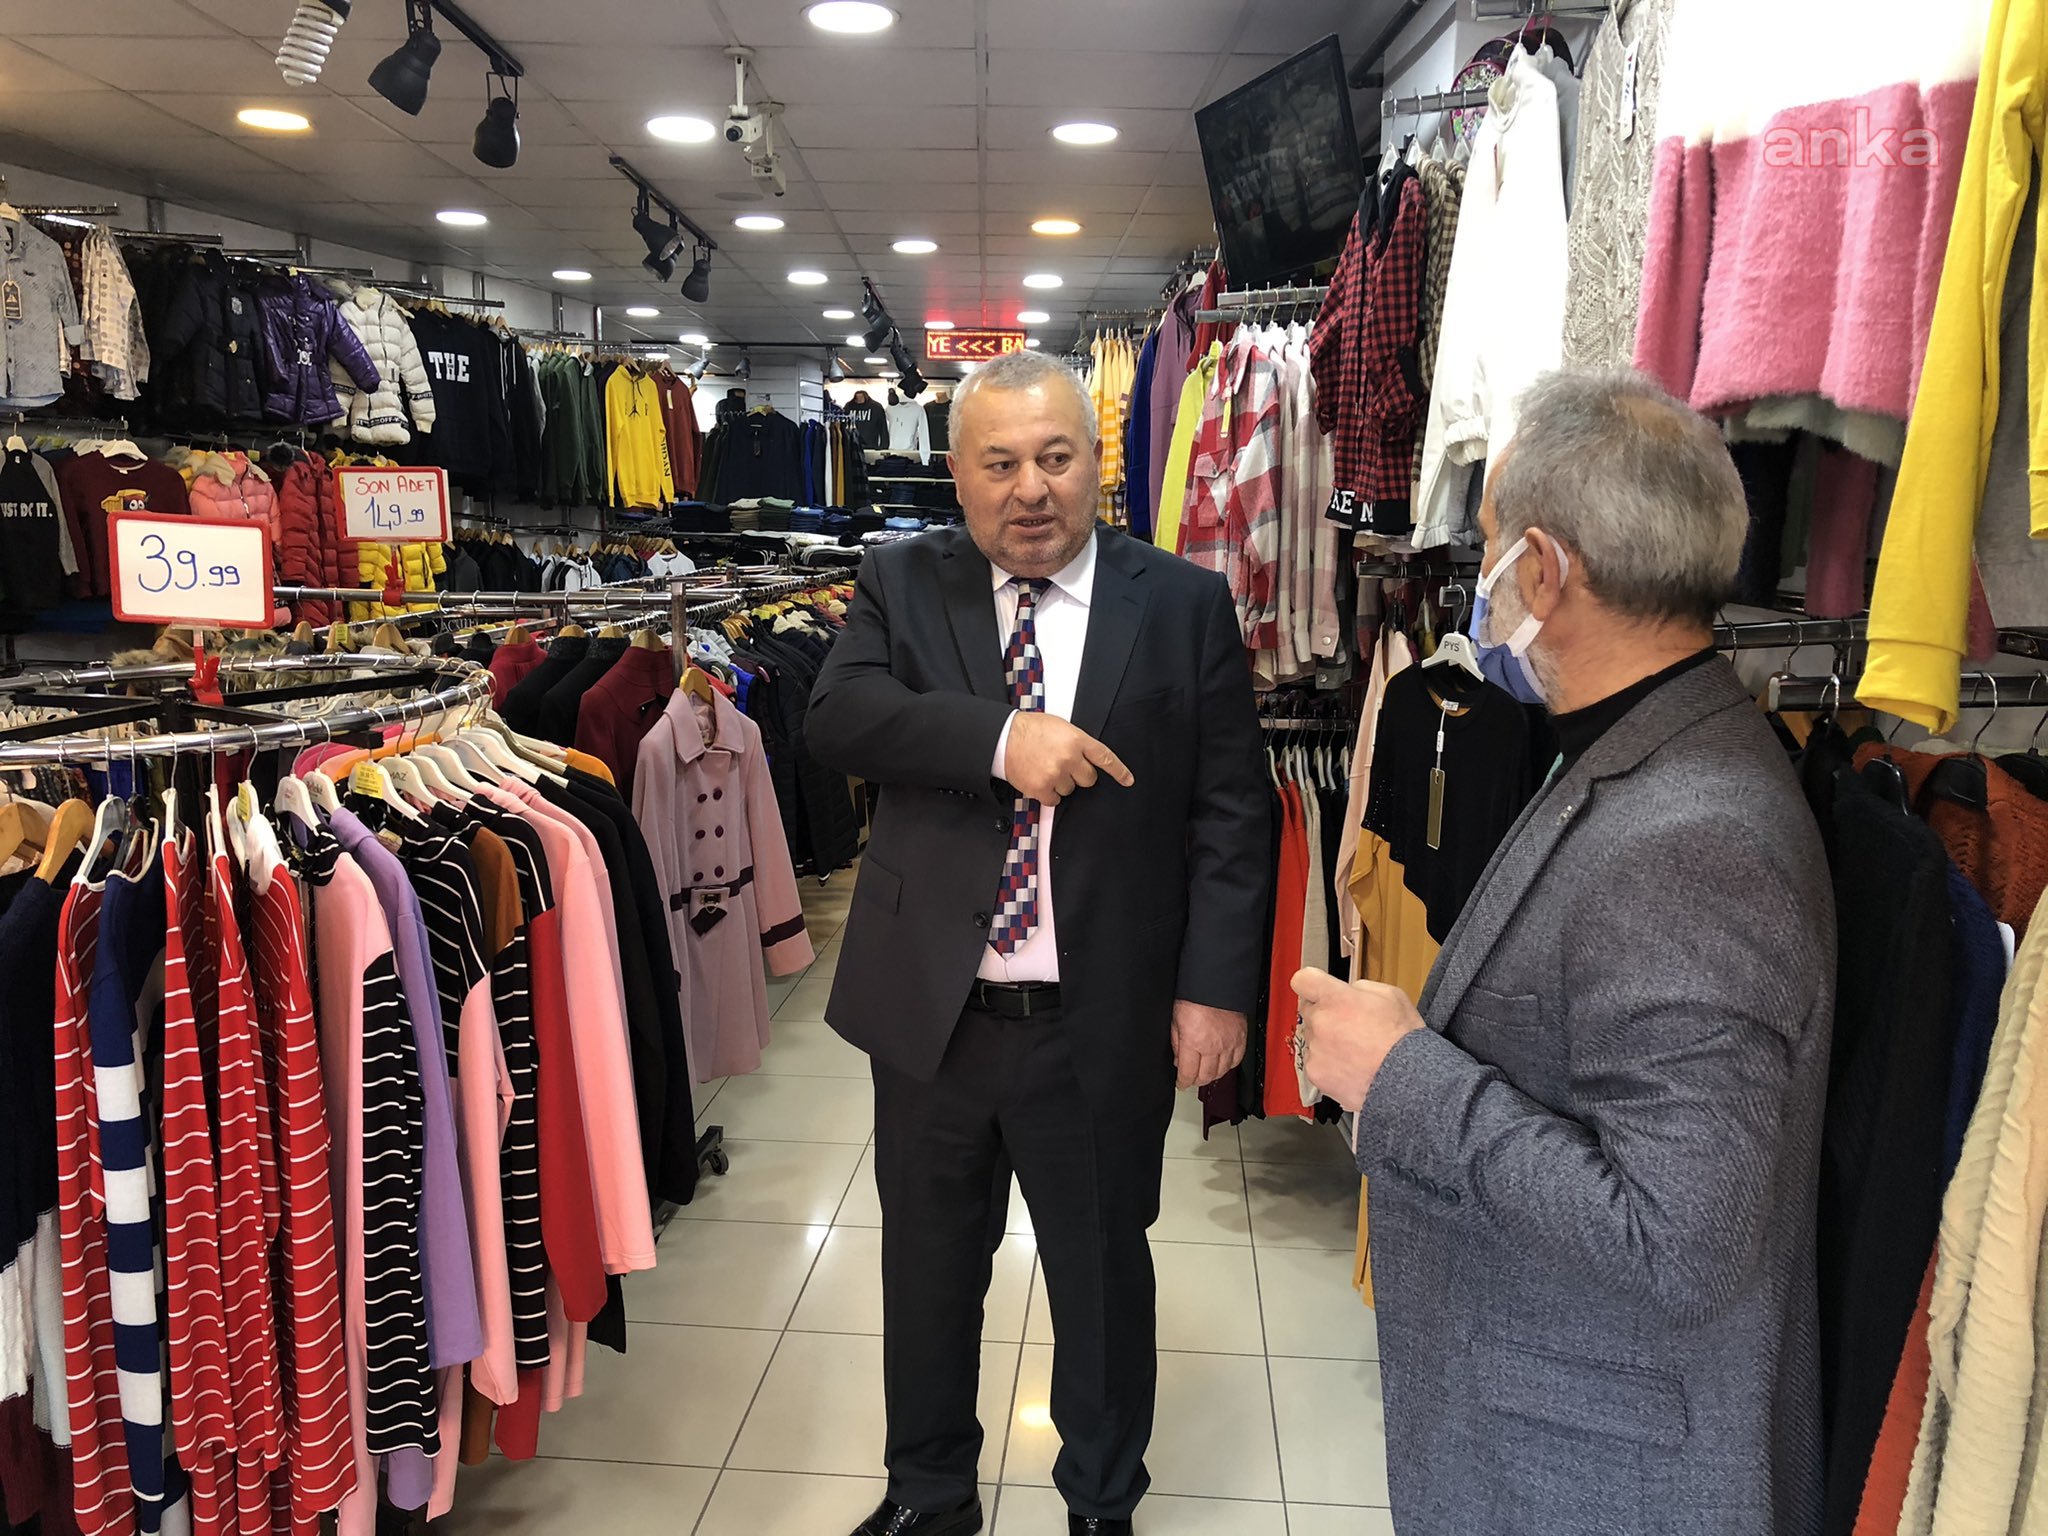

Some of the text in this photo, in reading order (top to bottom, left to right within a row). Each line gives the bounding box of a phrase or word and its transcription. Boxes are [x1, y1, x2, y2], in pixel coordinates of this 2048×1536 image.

[928, 336, 951, 353] YE
[428, 351, 470, 383] THE
[355, 475, 436, 496] SON ADET
[364, 496, 425, 531] 149.99
[138, 534, 241, 593] 39.99
